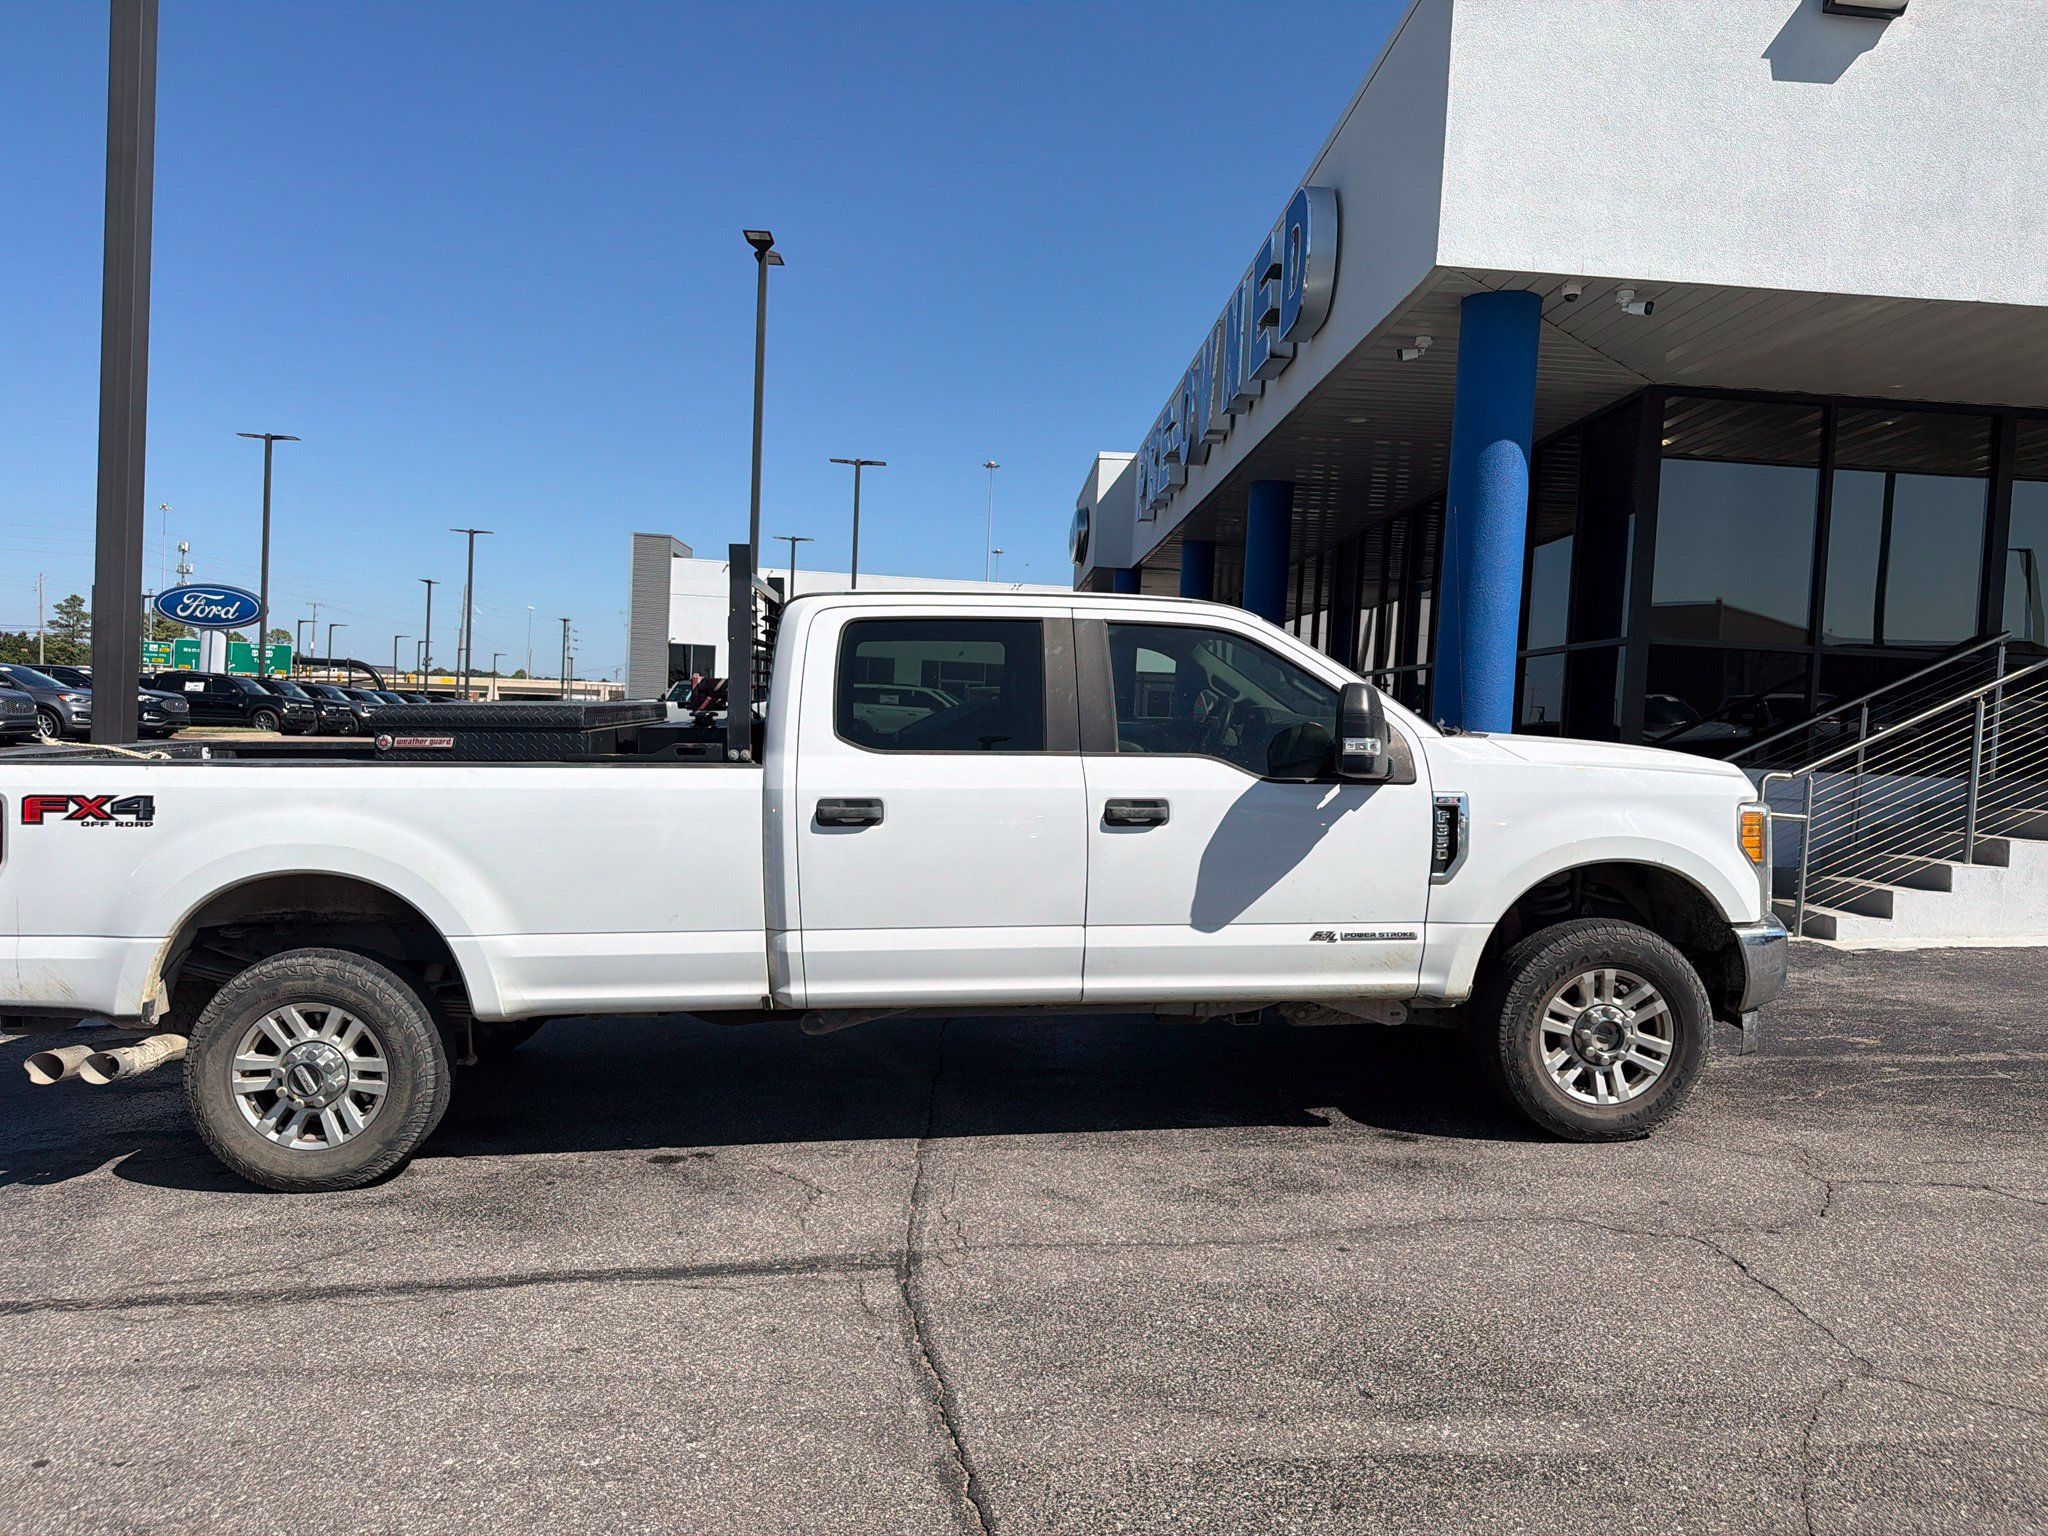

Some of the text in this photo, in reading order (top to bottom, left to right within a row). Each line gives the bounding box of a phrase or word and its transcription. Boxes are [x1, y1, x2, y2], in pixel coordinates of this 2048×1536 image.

[1136, 186, 1338, 522] PRE-OWNED
[176, 592, 240, 619] Ford
[396, 737, 452, 747] weather guard
[21, 794, 156, 825] FX4
